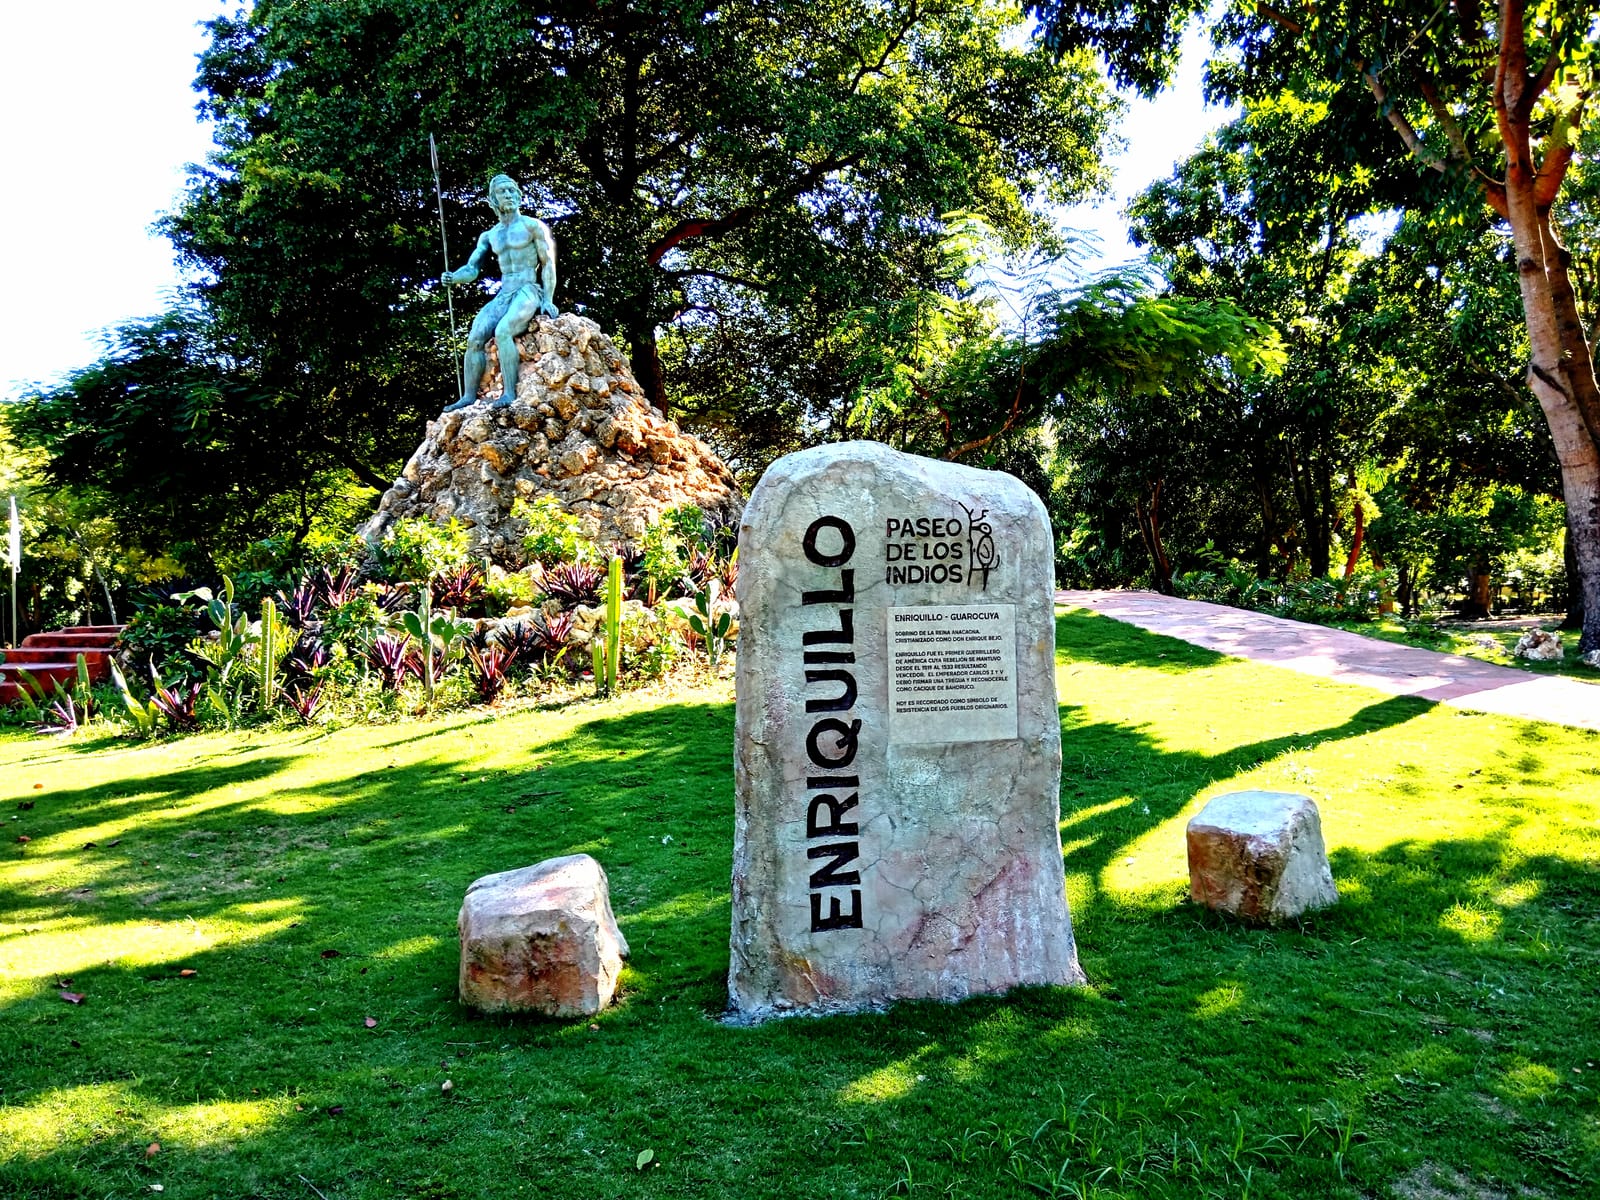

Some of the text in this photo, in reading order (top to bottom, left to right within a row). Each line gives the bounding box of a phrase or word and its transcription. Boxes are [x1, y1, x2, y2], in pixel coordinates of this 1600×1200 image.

[886, 518, 962, 537] PASEO
[886, 542, 963, 561] DE LOS
[886, 564, 963, 584] INDIOS
[951, 612, 999, 620] GUAROCUYA
[802, 515, 863, 933] ENRIQUILLO
